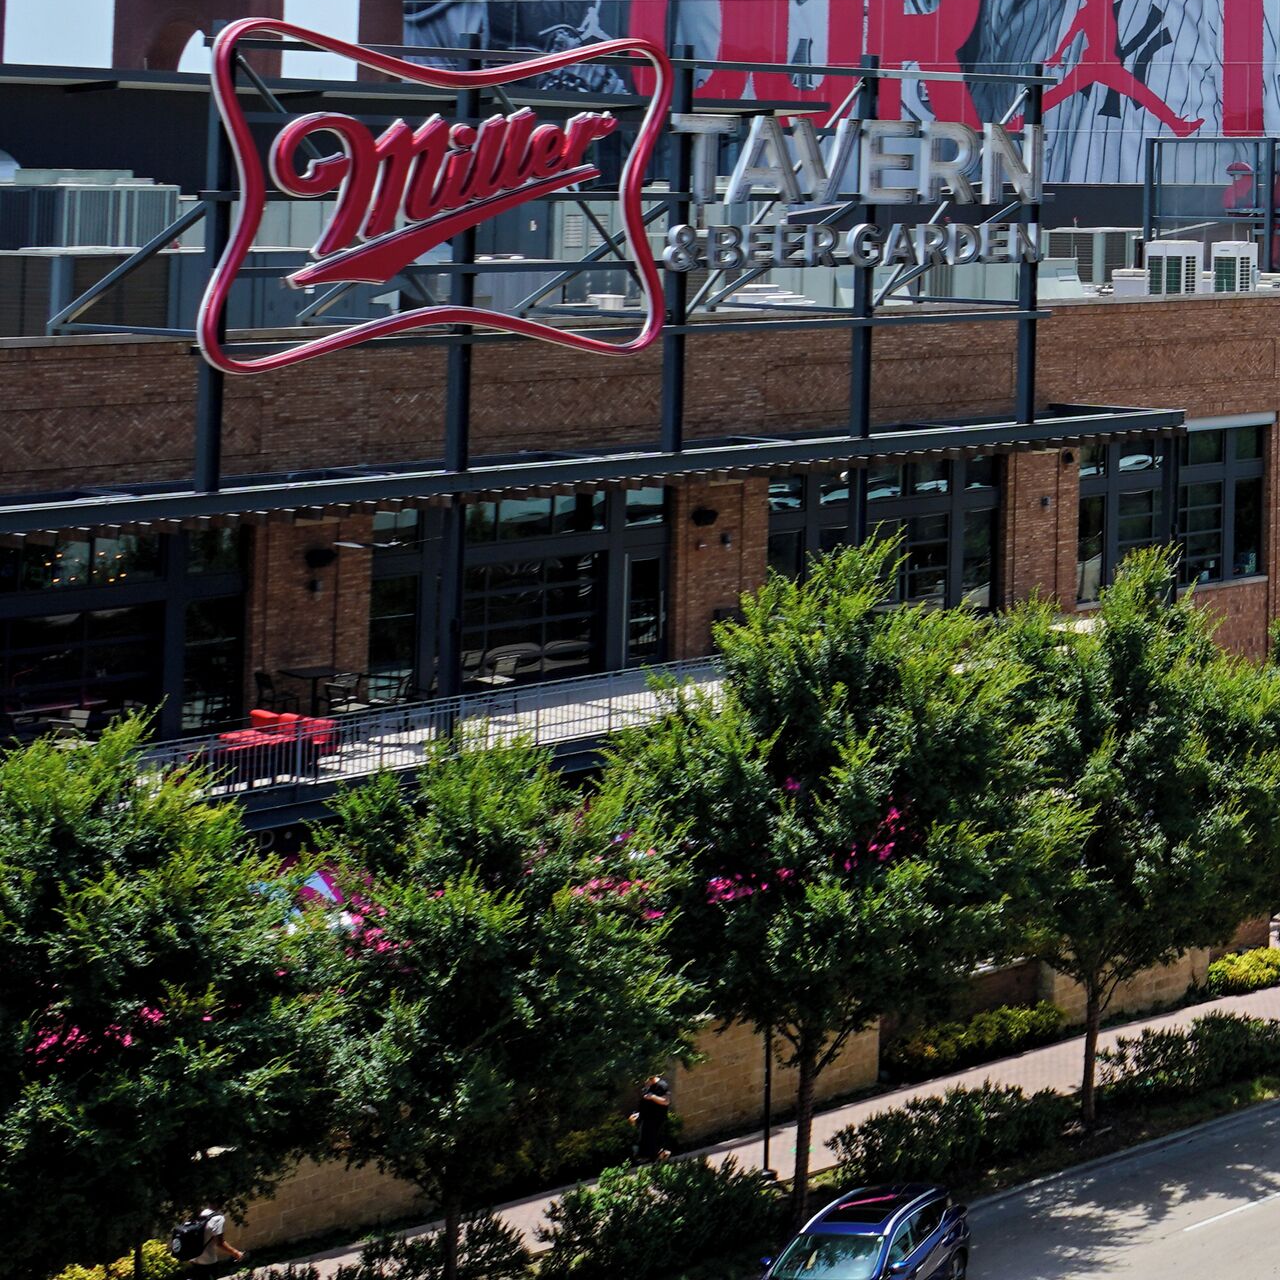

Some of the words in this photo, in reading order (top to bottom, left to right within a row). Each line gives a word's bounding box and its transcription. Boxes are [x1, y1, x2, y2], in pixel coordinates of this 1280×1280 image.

[269, 107, 618, 258] Miller
[670, 113, 1043, 205] TAVERN
[663, 224, 699, 272] &
[707, 224, 840, 269] BEER
[846, 223, 1043, 267] GARDEN
